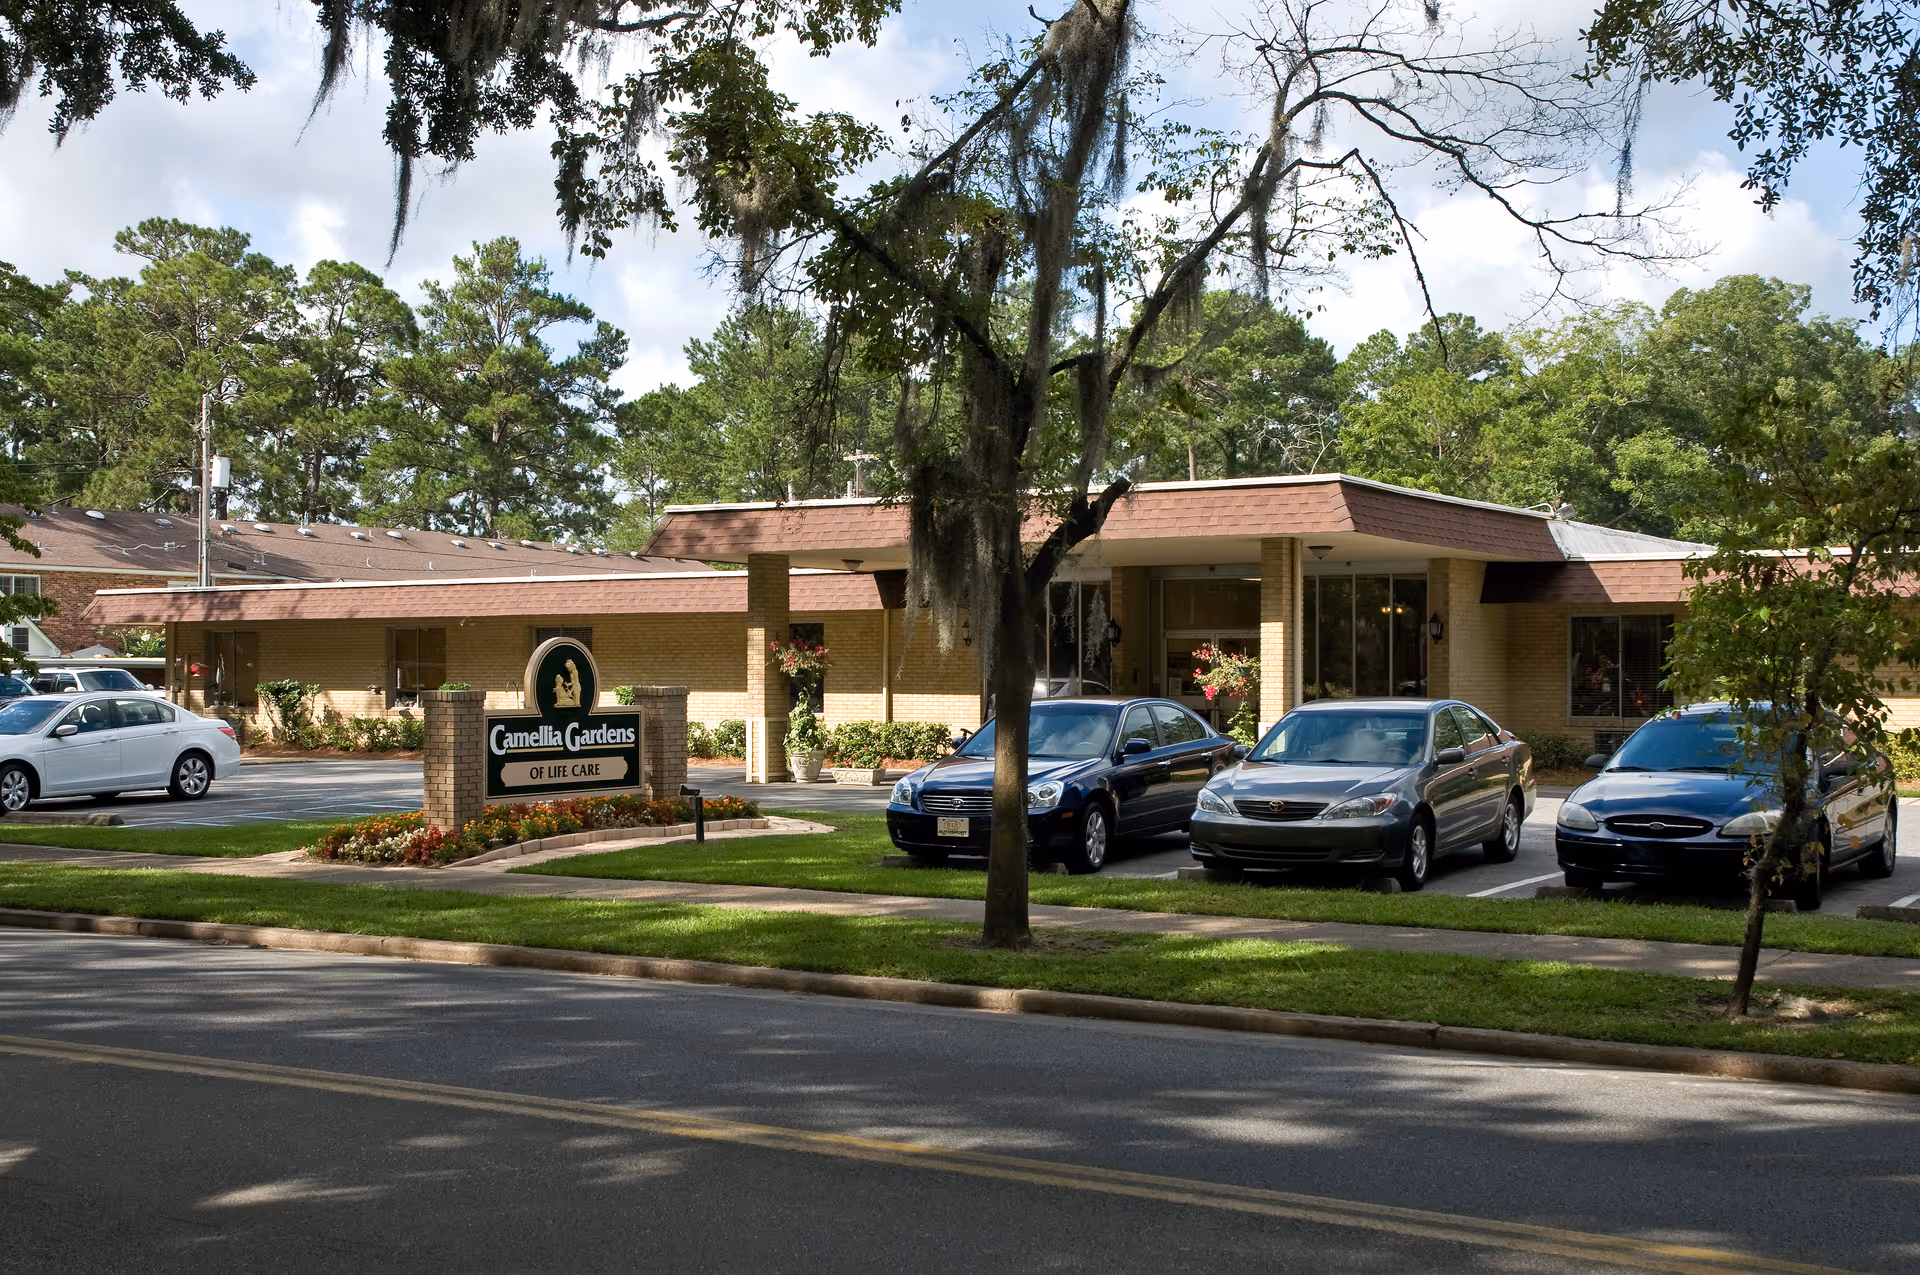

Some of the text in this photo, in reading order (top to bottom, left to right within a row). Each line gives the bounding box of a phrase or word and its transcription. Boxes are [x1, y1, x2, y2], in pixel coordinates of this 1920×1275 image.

[490, 722, 635, 755] Camellia Gardens
[530, 764, 600, 779] OF LIFE CARE
